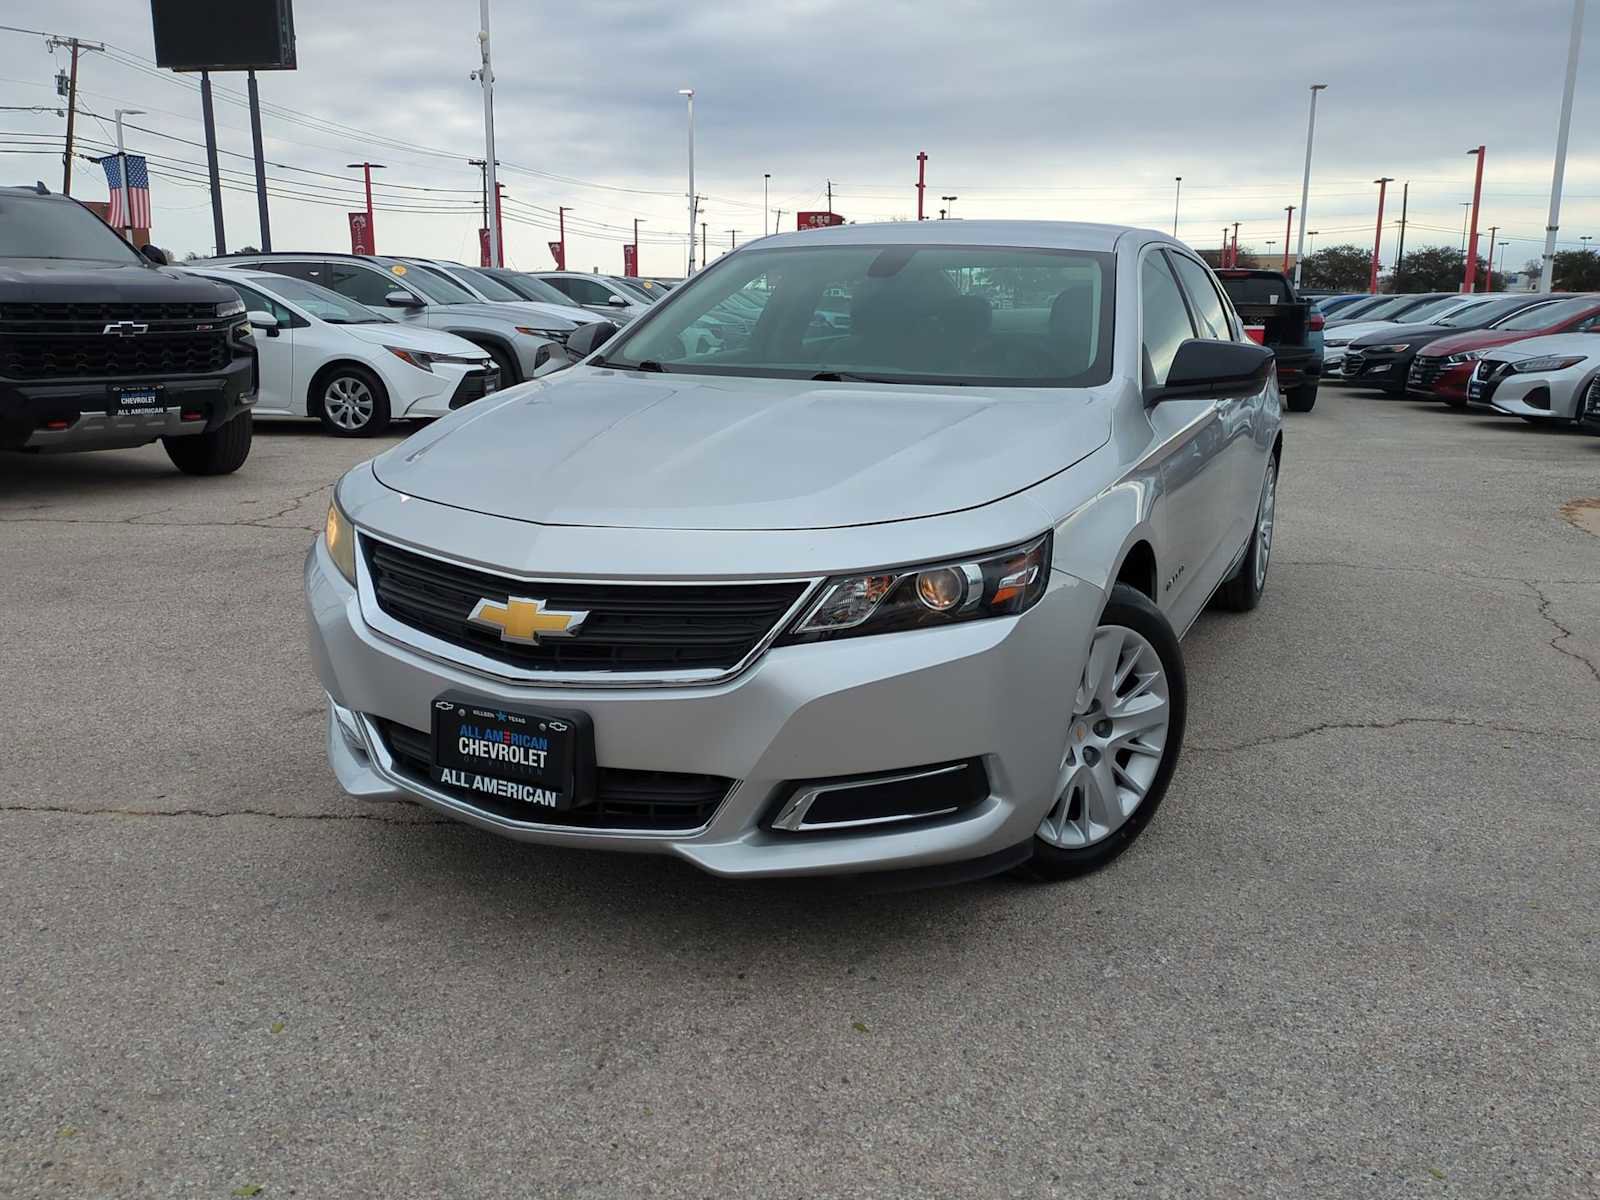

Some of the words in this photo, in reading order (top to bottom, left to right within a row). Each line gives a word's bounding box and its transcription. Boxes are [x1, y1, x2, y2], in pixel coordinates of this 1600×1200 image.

[120, 396, 156, 405] CHEVROLET
[458, 736, 548, 769] CHEVROLET
[460, 724, 482, 739] ALL
[484, 728, 548, 751] AMERICAN
[441, 768, 469, 789] ALL
[472, 775, 557, 808] AMERICAN
